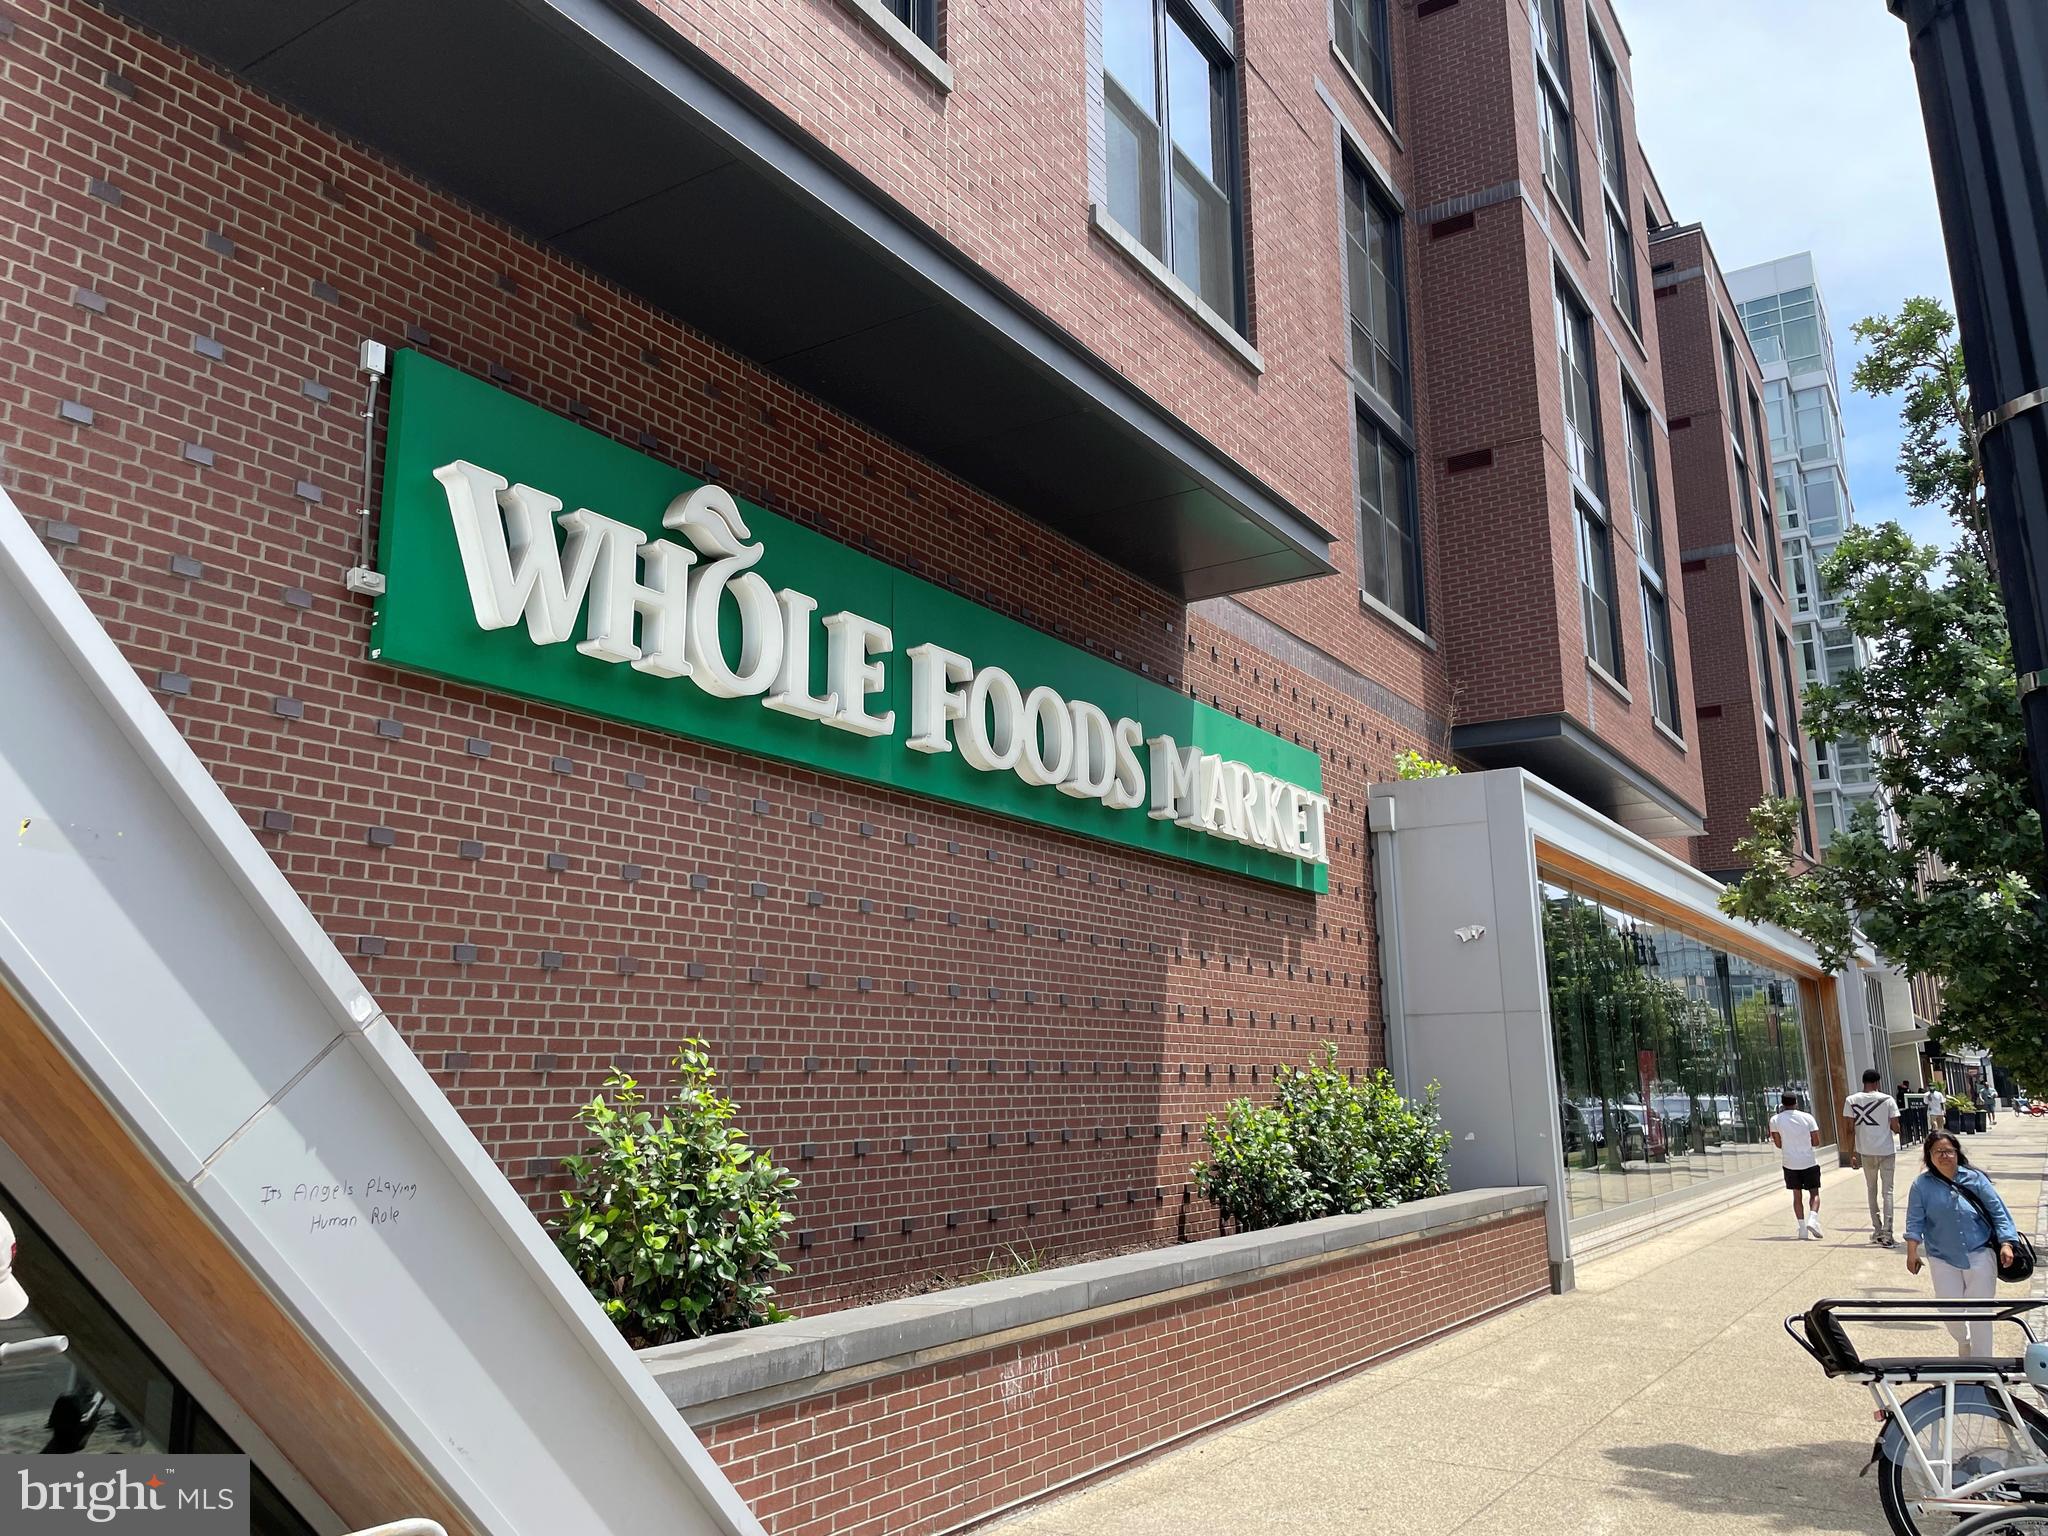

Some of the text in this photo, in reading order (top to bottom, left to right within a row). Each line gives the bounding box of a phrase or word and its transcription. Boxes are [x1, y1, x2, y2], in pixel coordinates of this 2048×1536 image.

[433, 459, 1331, 865] WHOLE FOODS MARKET
[294, 1180, 354, 1202] Angels
[310, 1206, 400, 1234] Human Role
